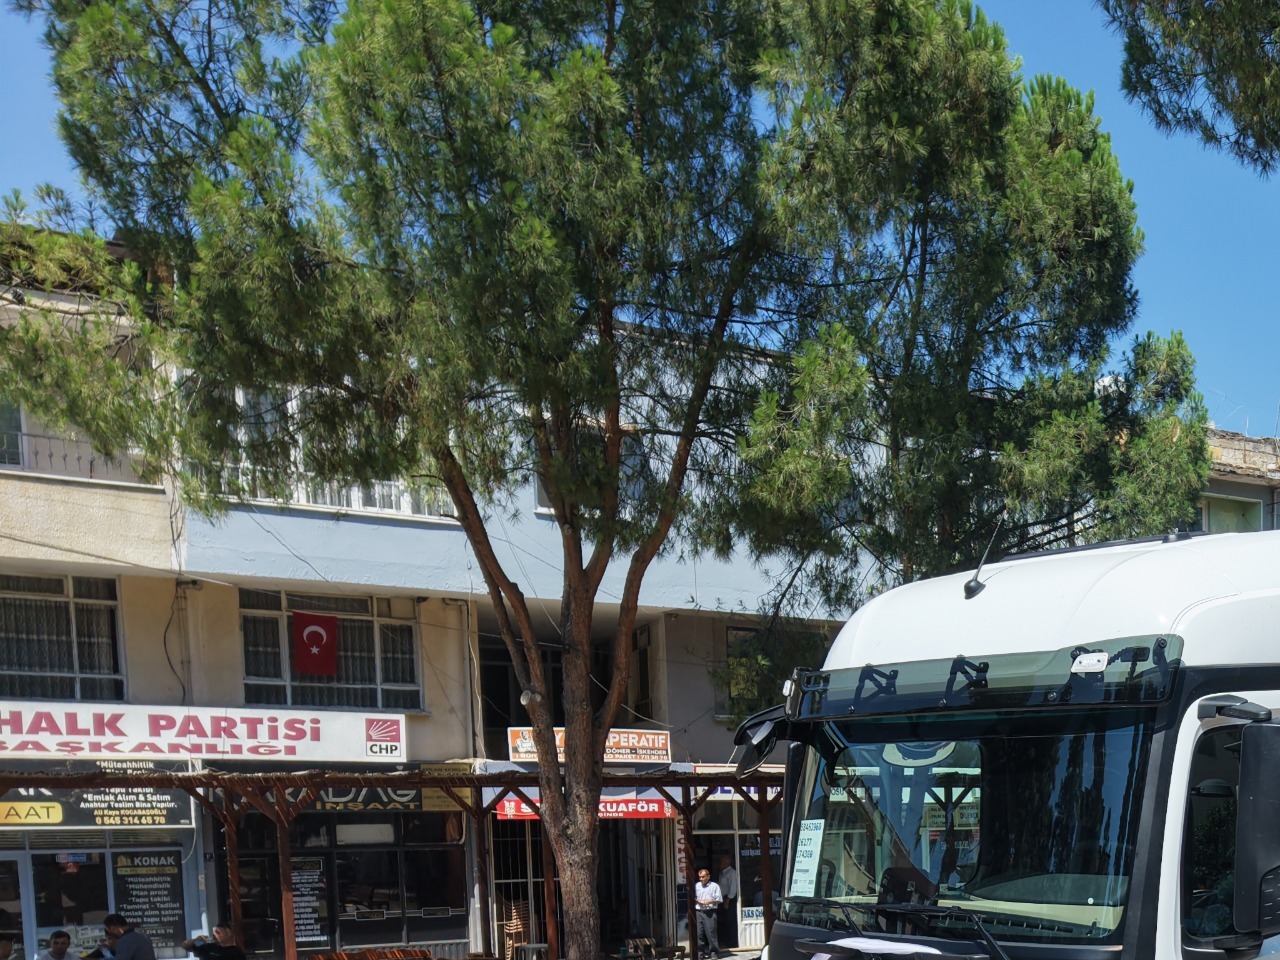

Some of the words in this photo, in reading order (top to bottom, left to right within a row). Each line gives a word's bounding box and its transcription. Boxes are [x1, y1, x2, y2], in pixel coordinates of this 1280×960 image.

[0, 710, 127, 736] HALK
[148, 714, 321, 741] PARTİSİ
[370, 743, 398, 755] CHP
[96, 816, 102, 824] 0
[133, 856, 175, 866] KONAK
